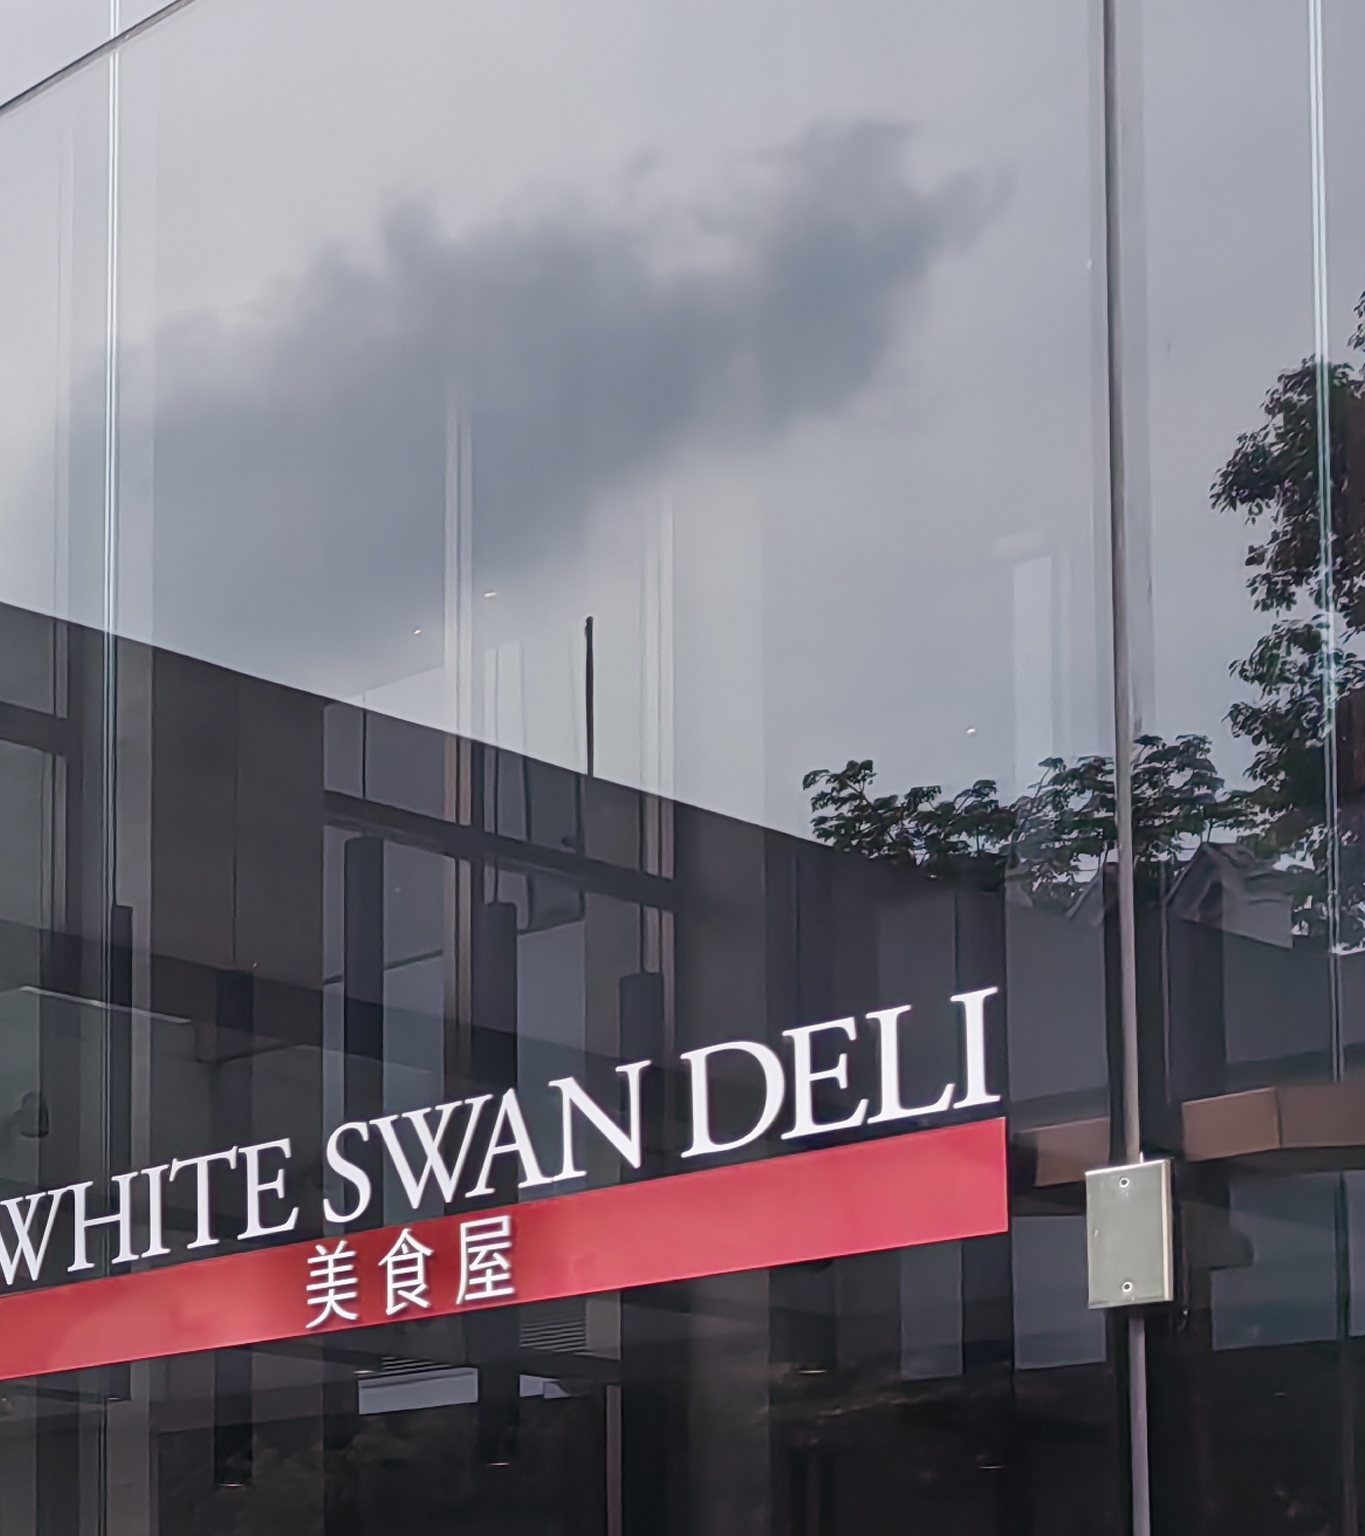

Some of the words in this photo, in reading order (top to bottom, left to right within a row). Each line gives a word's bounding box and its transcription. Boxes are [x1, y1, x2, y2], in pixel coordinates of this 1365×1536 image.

[323, 1060, 651, 1224] SWAN
[680, 986, 1001, 1158] DELI
[305, 1215, 515, 1329] 美食屋
